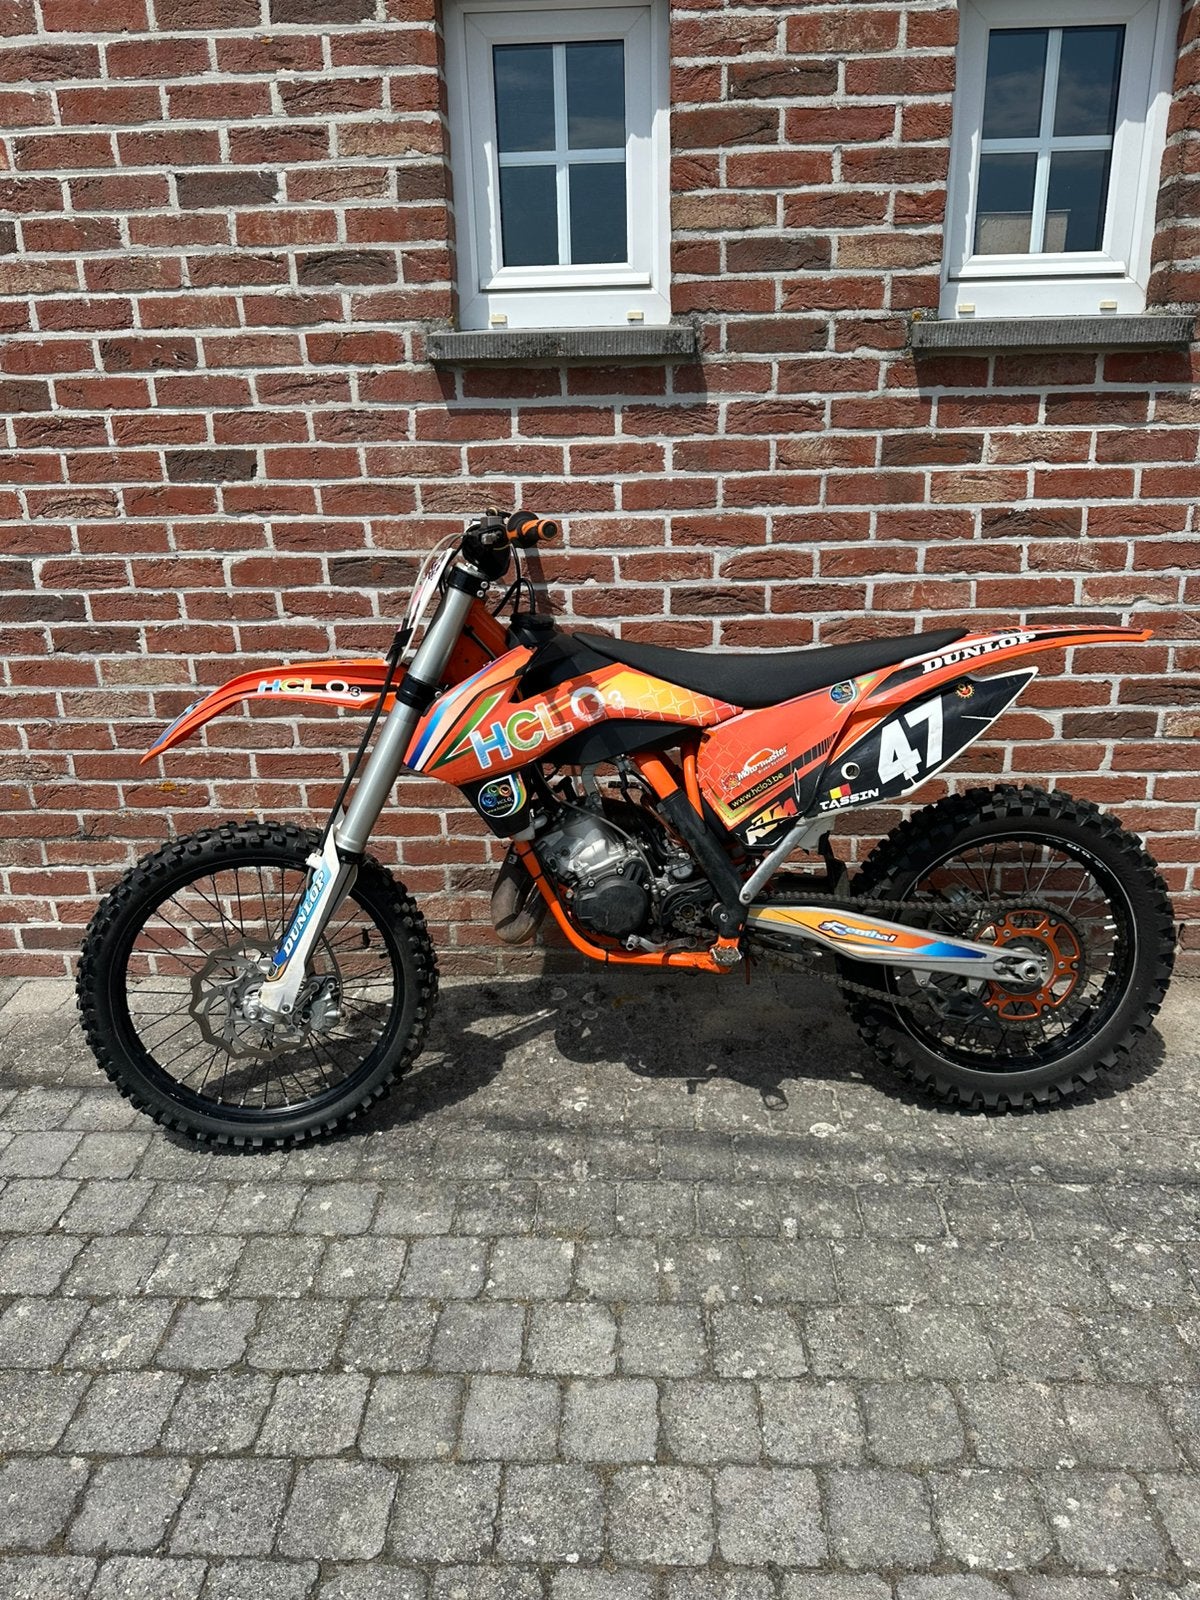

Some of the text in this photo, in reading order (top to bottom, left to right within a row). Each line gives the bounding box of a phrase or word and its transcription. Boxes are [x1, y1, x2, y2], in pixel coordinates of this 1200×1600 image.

[921, 633, 1037, 675] DUNLOP
[877, 694, 944, 785] 47
[731, 772, 785, 808] www.hclo3.be
[819, 788, 880, 811] TASSIN
[745, 797, 798, 846] KTM
[283, 870, 325, 958] DUNLOP
[818, 920, 898, 943] Renthal
